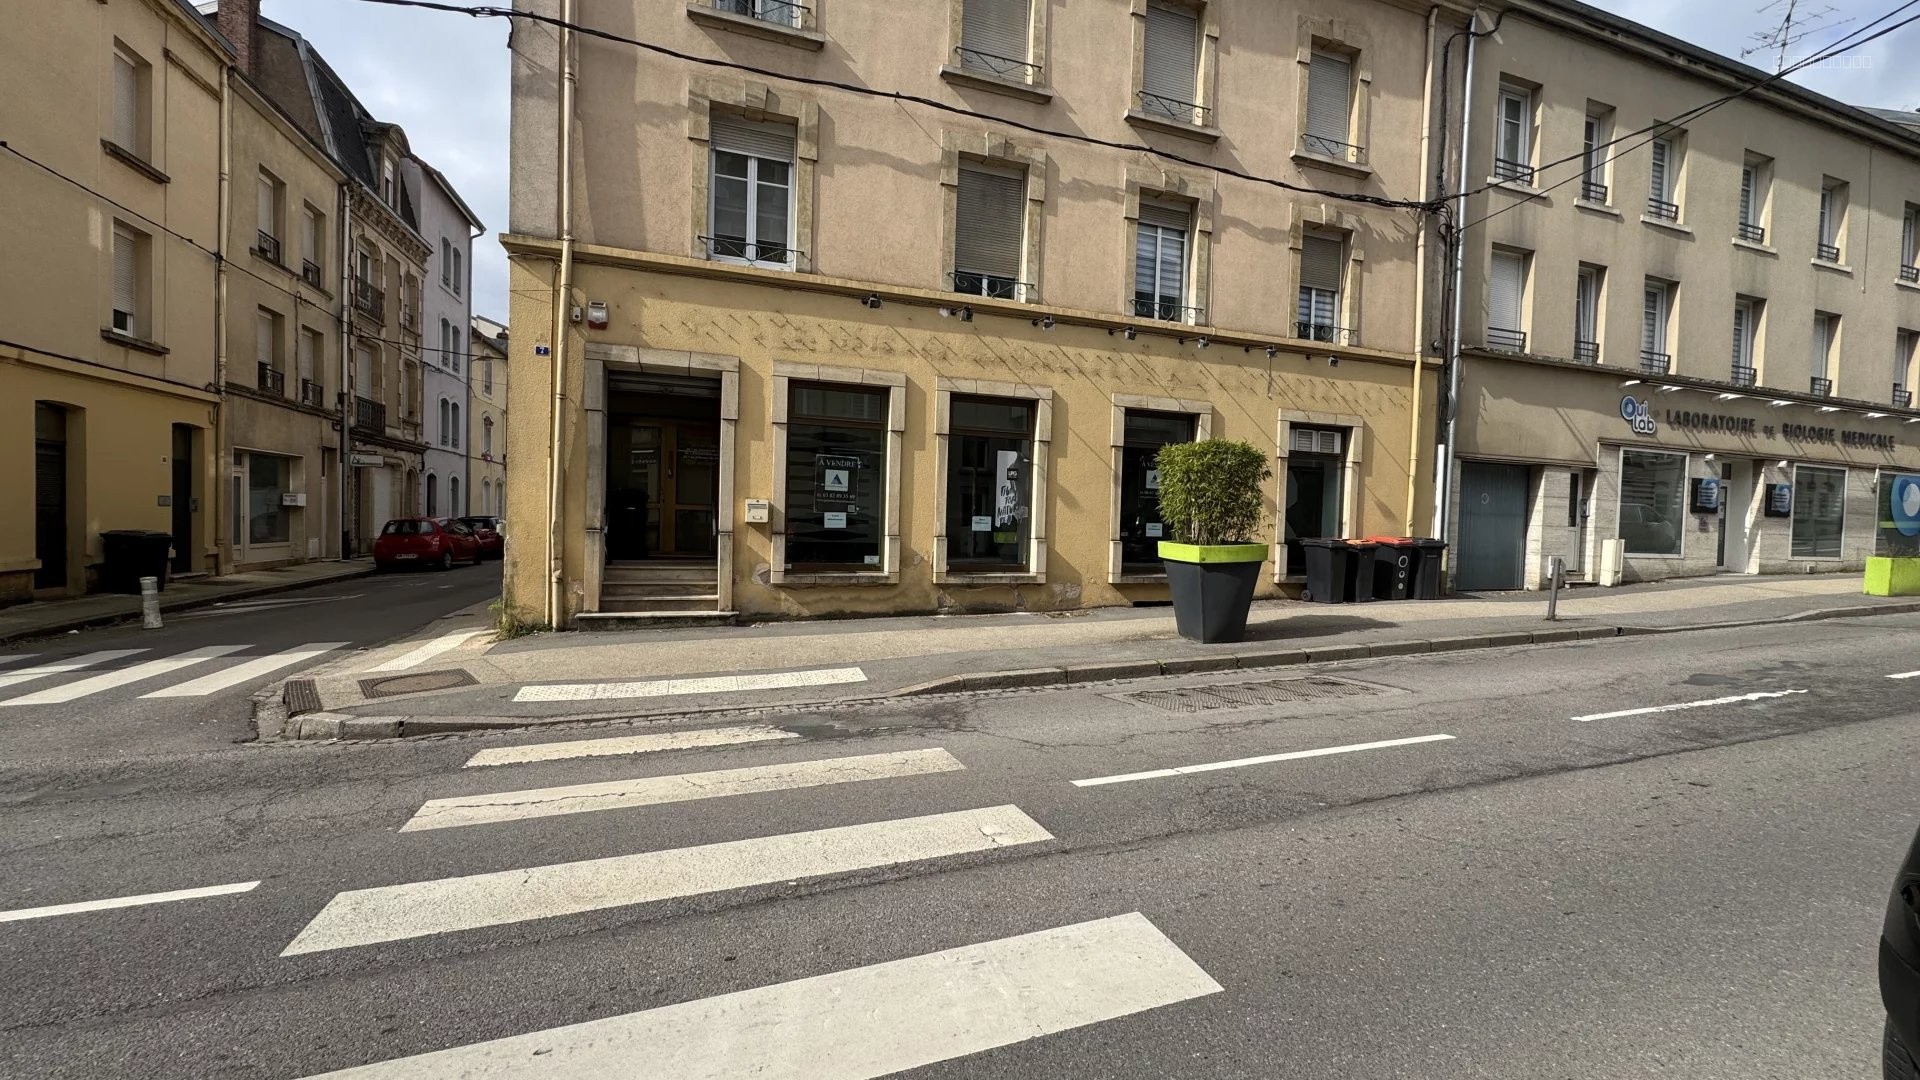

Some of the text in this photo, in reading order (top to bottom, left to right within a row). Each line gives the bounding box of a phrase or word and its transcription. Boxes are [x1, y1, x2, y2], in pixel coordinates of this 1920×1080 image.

[1621, 396, 1648, 420] Oui
[1632, 415, 1655, 433] lab
[1666, 409, 1895, 449] LABORATOIRE DE BIOLOGIE MEDICALE
[826, 459, 857, 467] VENDRE
